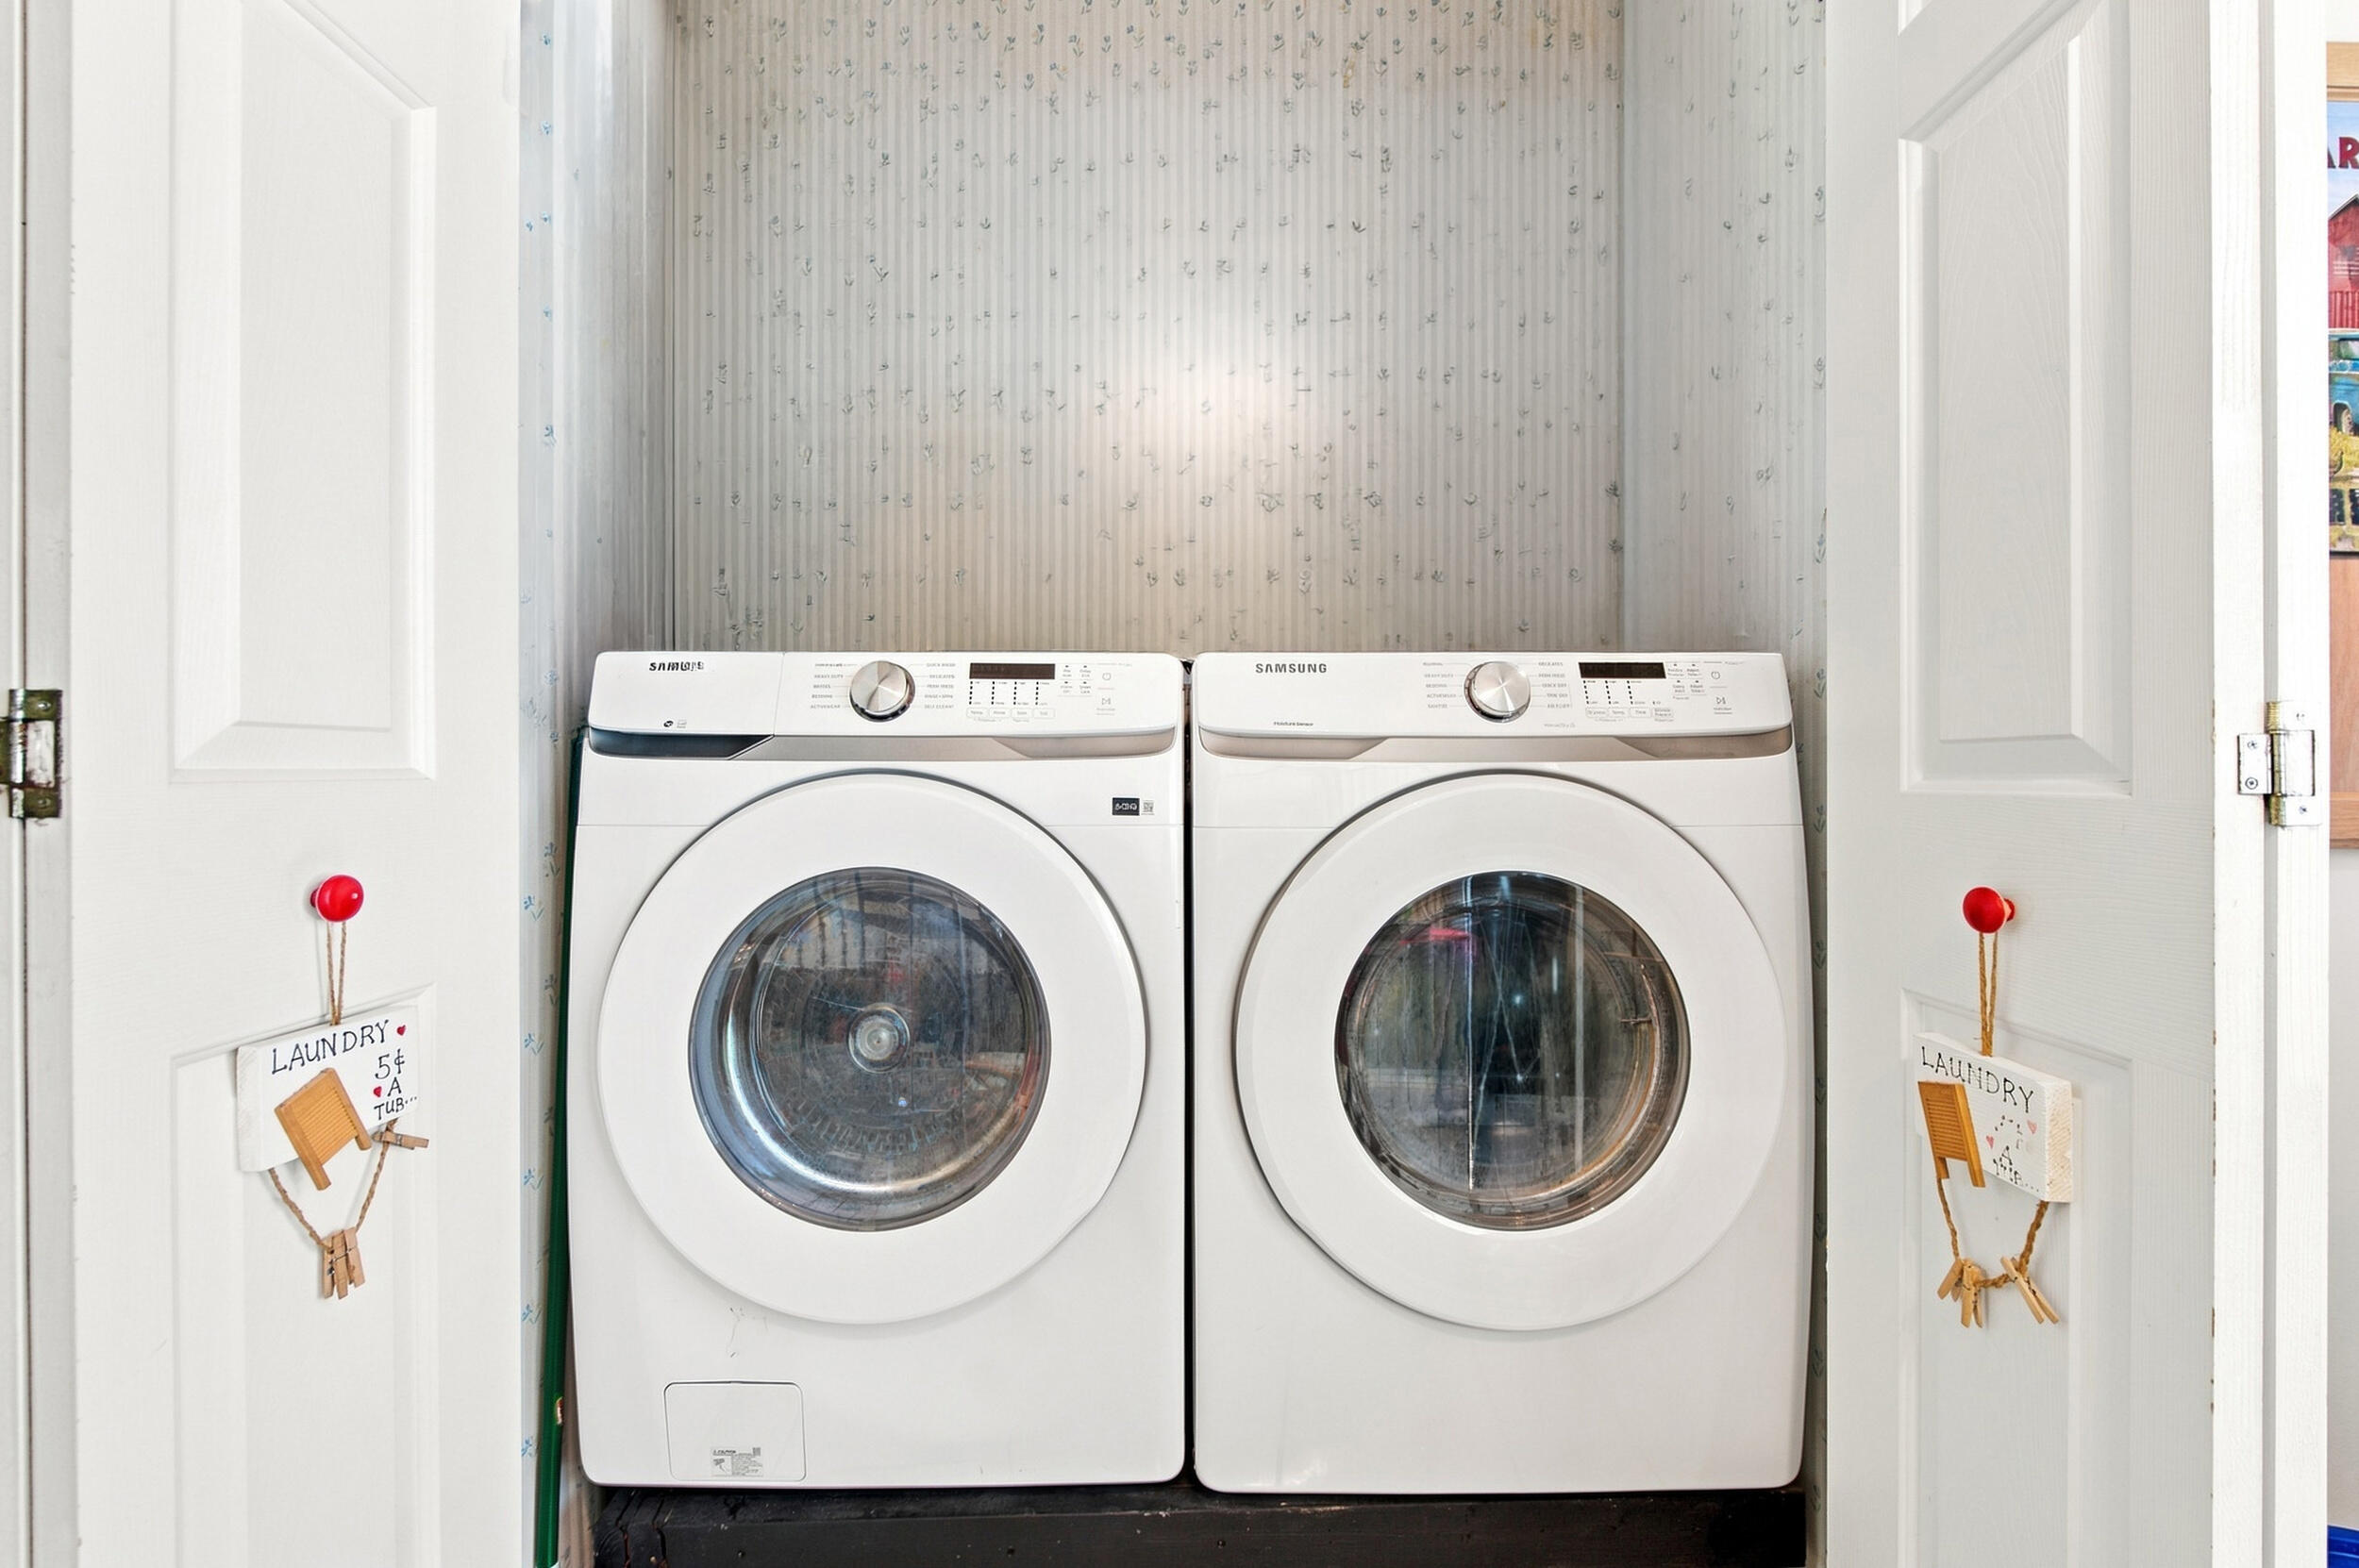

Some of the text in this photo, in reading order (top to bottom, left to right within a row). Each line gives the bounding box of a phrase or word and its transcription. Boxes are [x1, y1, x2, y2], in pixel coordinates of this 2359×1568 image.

[1255, 662, 1327, 674] SAMSUNG
[271, 1019, 390, 1076] LAUNDRY
[375, 1048, 406, 1080] 5¢
[1921, 1045, 2034, 1114] LAUNDRY
[387, 1076, 402, 1097] A
